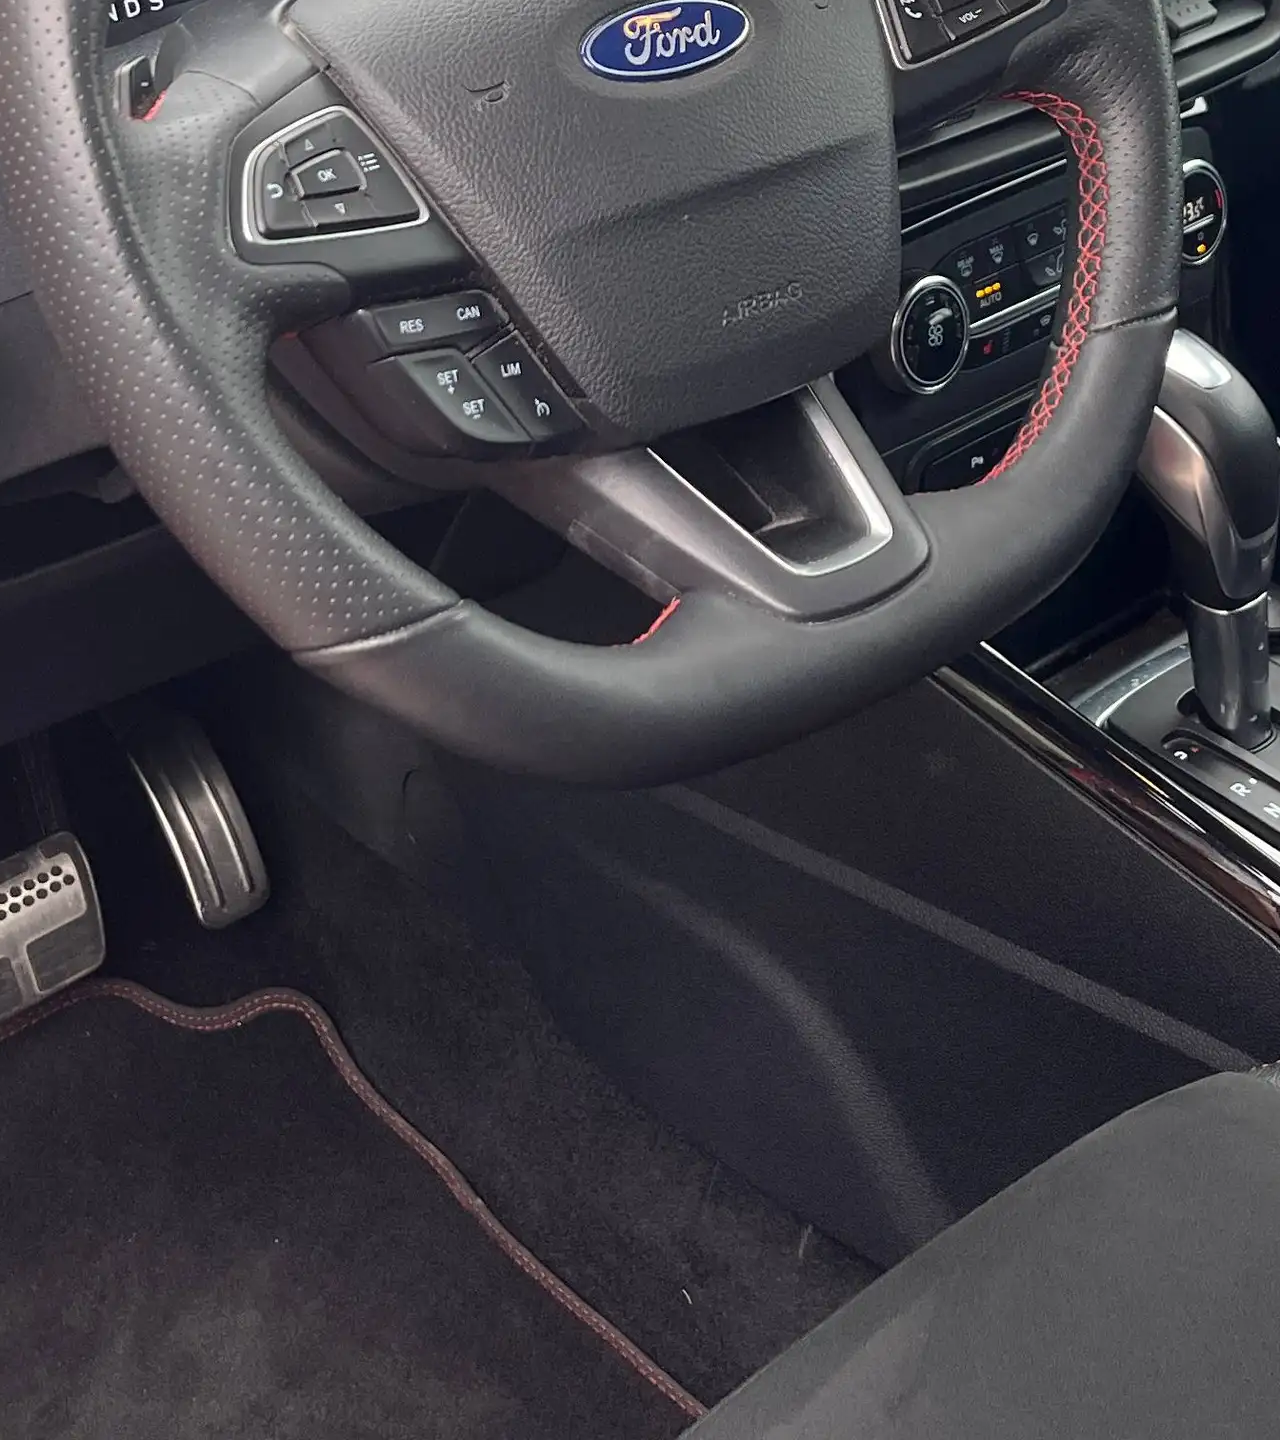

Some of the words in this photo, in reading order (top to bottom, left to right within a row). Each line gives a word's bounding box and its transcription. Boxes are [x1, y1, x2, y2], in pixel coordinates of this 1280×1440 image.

[623, 6, 721, 65] Ford
[317, 167, 337, 183] OK
[980, 291, 1002, 308] AUTO
[399, 318, 425, 334] RES
[456, 305, 481, 321] CAN
[436, 369, 459, 386] SET
[500, 362, 522, 378] LIM
[462, 398, 485, 416] SET
[1229, 782, 1252, 798] R
